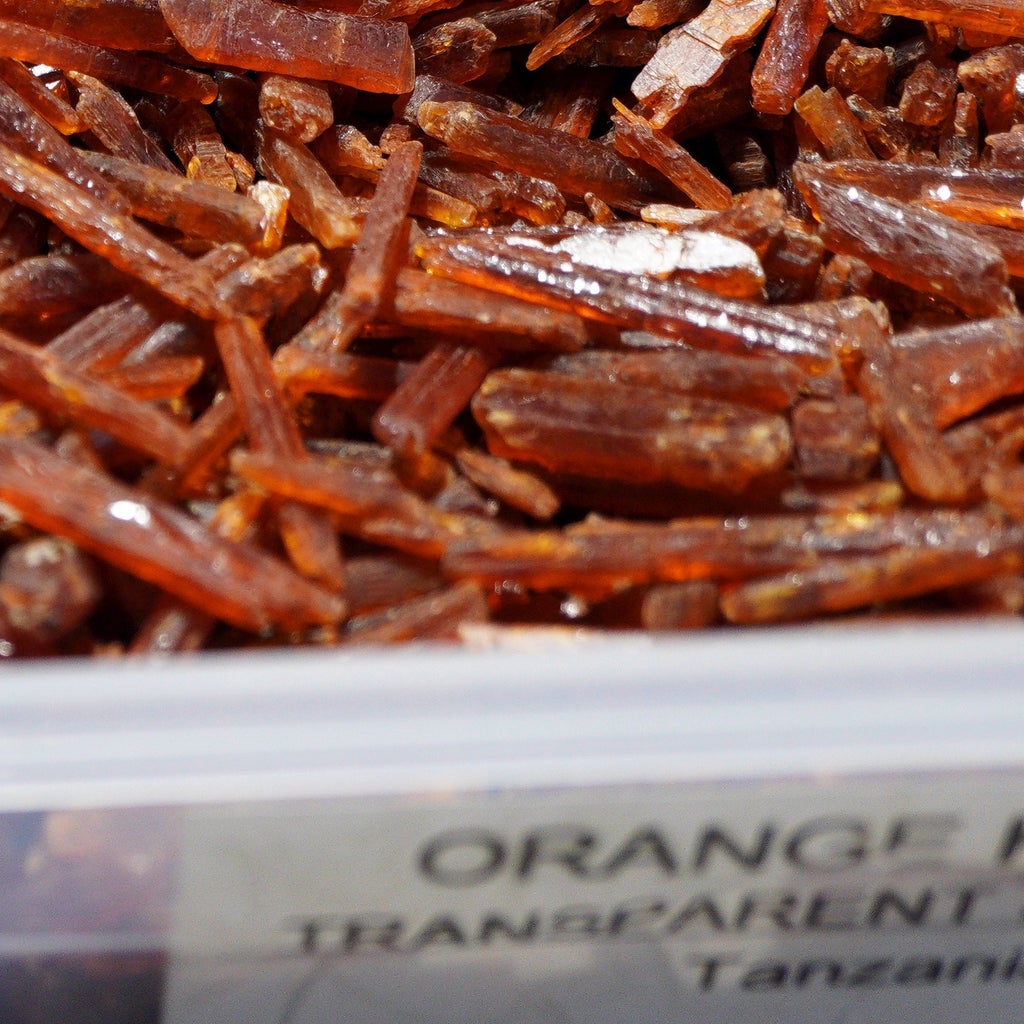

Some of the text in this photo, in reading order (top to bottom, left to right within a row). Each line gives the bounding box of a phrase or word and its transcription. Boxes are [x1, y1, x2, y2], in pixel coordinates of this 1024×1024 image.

[416, 813, 962, 890] ORANGE
[284, 883, 998, 956] TRANSPARENT
[687, 947, 1024, 992] Tanzani
